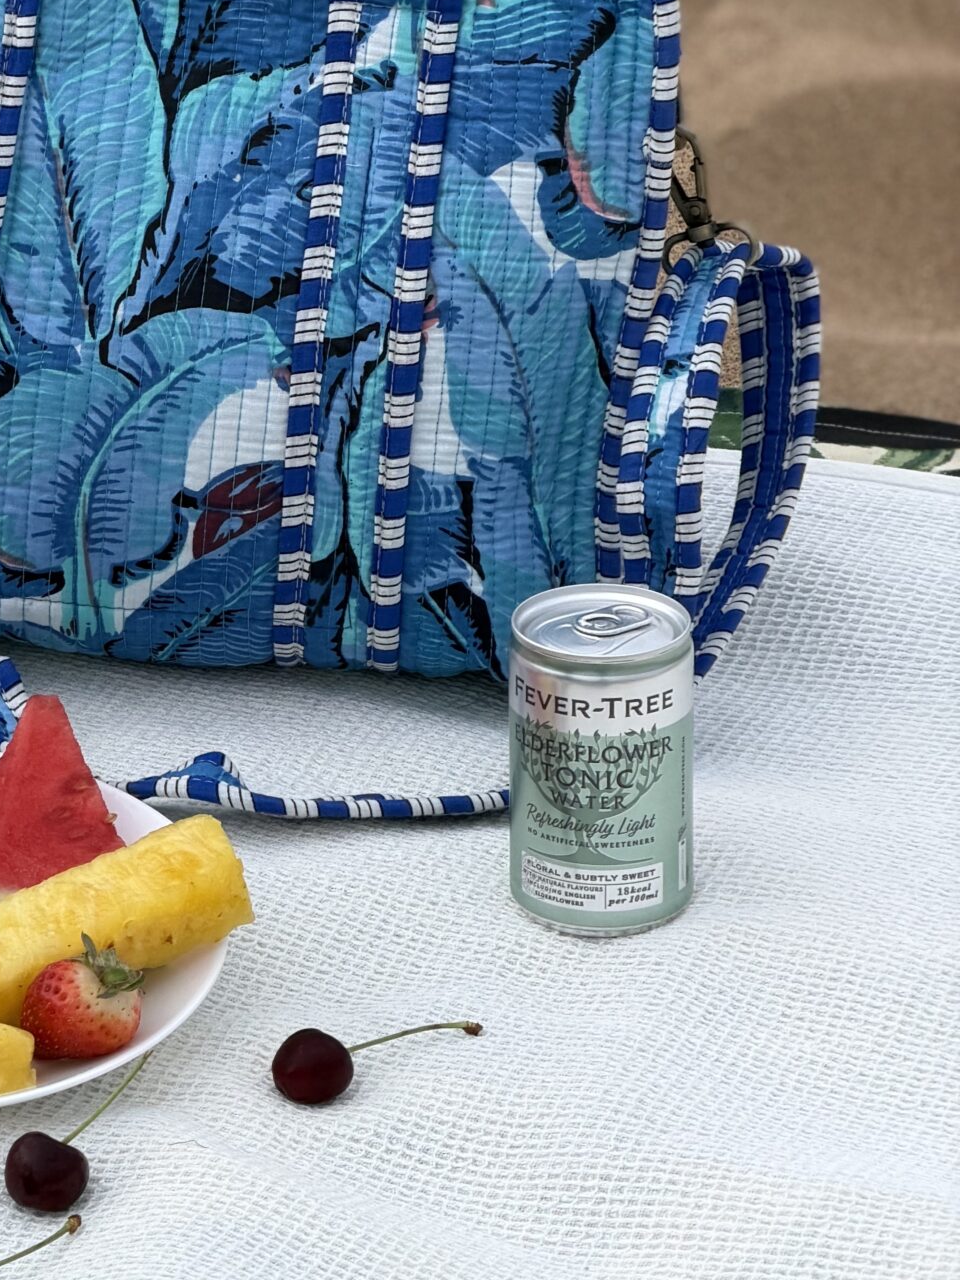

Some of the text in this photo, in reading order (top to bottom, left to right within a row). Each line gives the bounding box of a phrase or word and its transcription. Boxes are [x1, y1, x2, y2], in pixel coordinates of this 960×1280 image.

[515, 675, 674, 719] FEVER-TREE
[515, 724, 674, 764] ELDERFLOWER
[541, 762, 634, 790] TONIC
[547, 786, 627, 809] WATER
[526, 803, 657, 839] Refreshingly Light
[528, 827, 655, 848] NO ARTIFICIAL SWEETENERS
[575, 873, 618, 882] SUBTLY
[621, 869, 656, 881] SWEET
